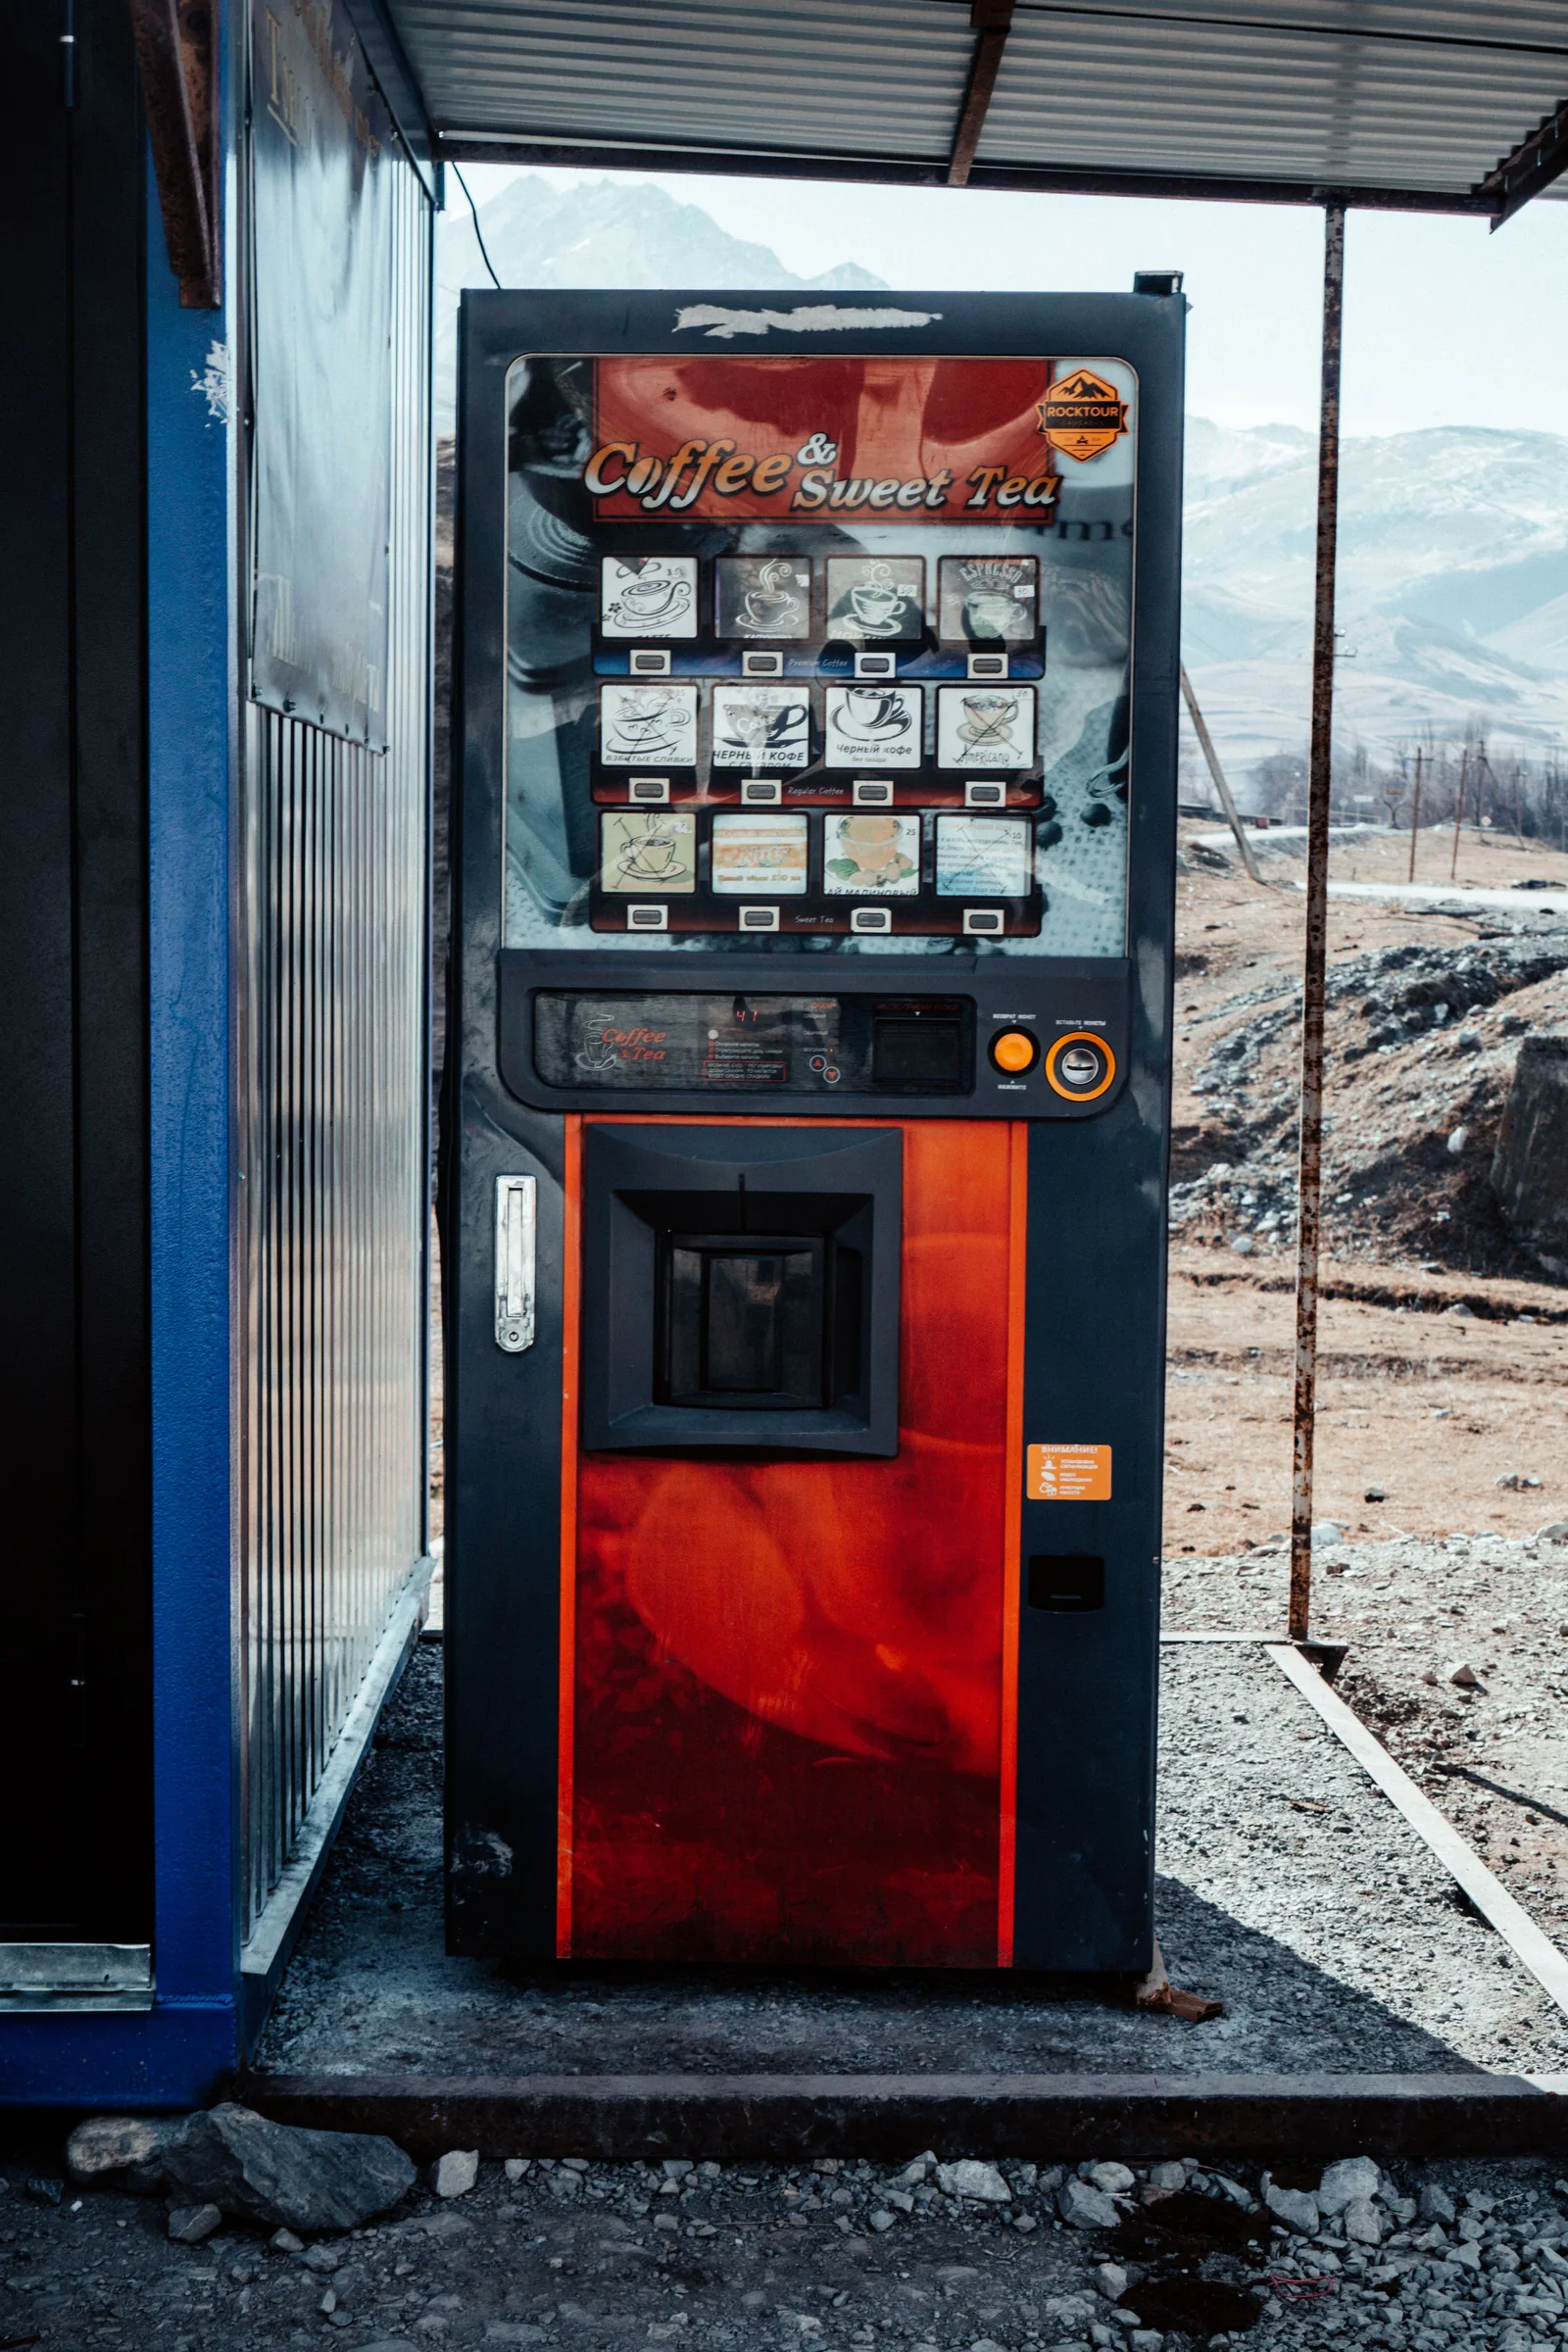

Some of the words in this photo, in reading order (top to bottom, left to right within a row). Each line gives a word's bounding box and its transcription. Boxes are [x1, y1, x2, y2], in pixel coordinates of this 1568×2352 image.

[1047, 407, 1119, 416] ROCKTOUR
[583, 438, 794, 511] Coffee
[797, 431, 837, 467] &
[791, 468, 952, 512] Sweet
[964, 466, 1063, 509] Tea
[959, 563, 1023, 584] ESPRESSO
[822, 659, 849, 668] Coffee
[837, 744, 880, 755] Черный
[882, 746, 912, 756] кофе
[769, 752, 805, 761] КОФЕ
[788, 786, 816, 797] Regular
[818, 787, 844, 796] Coffee
[820, 915, 834, 924] Tea
[602, 1028, 666, 1047] Coffee
[632, 1047, 665, 1060] Tea
